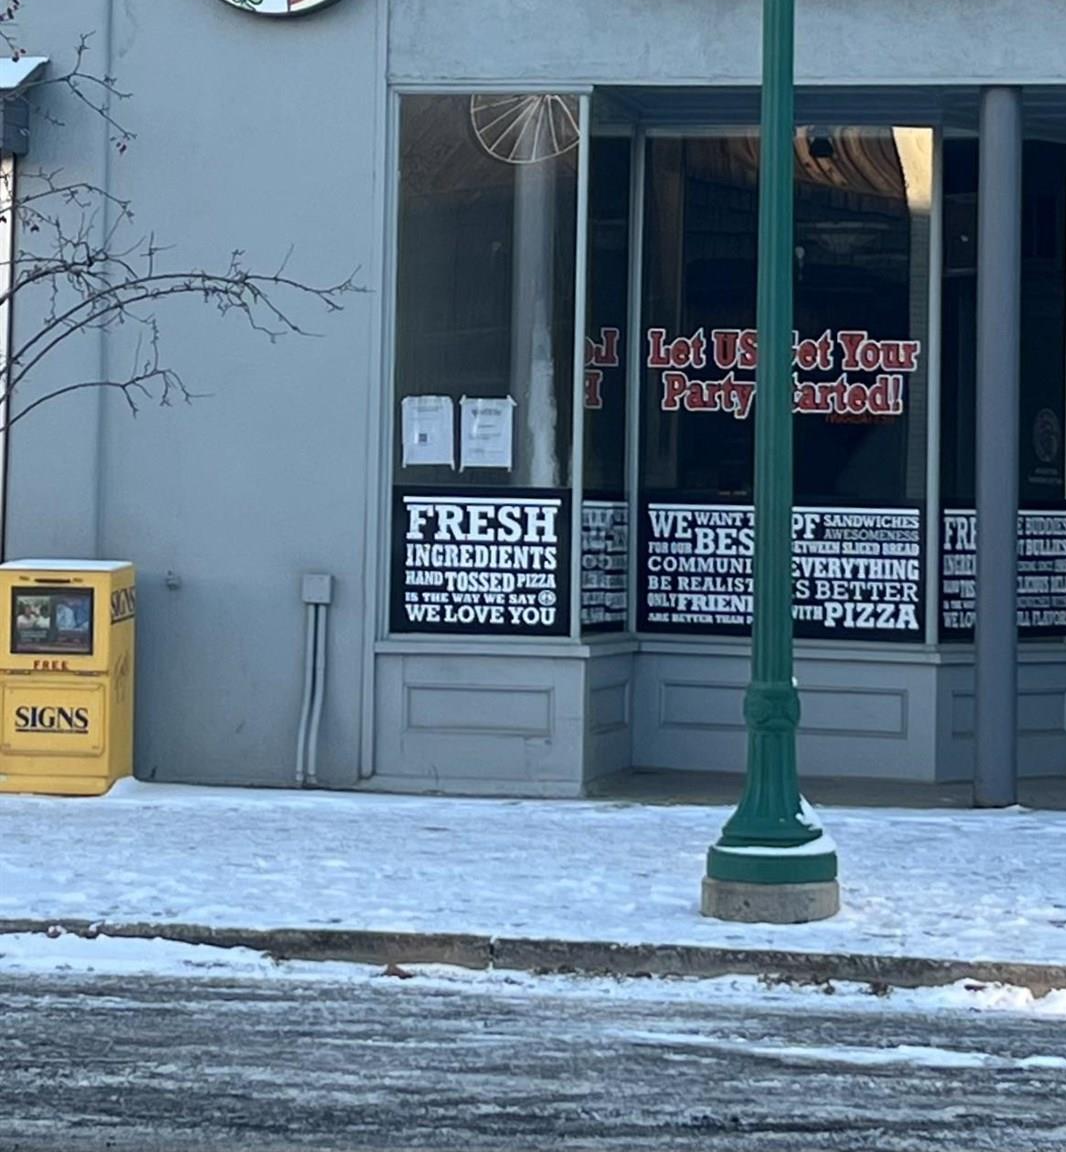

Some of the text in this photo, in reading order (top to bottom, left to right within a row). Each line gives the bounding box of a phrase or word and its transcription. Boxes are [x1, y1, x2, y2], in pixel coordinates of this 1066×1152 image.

[648, 327, 706, 369] Let
[711, 329, 757, 371] US
[792, 329, 834, 370] et
[837, 330, 920, 372] Your
[661, 370, 756, 419] Party
[406, 504, 558, 542] FRESH
[648, 511, 692, 538] WE
[694, 512, 743, 526] WANT
[792, 513, 919, 539] PF SANDWICHES
[648, 528, 755, 556] FOR OUR BES
[823, 528, 919, 541] AWESOMENESS
[406, 544, 557, 570] INGREDIENTS
[792, 540, 919, 556] ETWEEN SLICED BREAD
[648, 556, 752, 574] COMMUNI
[405, 570, 556, 592] HAND TOSSED PIZZA
[648, 575, 672, 590] BE
[792, 579, 810, 599] S
[815, 580, 919, 602] BETTER
[405, 592, 537, 605] IS THE WAY WE SAY
[647, 592, 754, 612] ONLY FRIEN
[405, 604, 556, 625] WE LOVE YOU
[648, 612, 670, 622] ARE
[671, 613, 714, 623] BETTER
[715, 614, 744, 624] THAN
[824, 601, 919, 630] PIZZA
[33, 660, 69, 671] FREE
[15, 706, 89, 730] SIGNS
